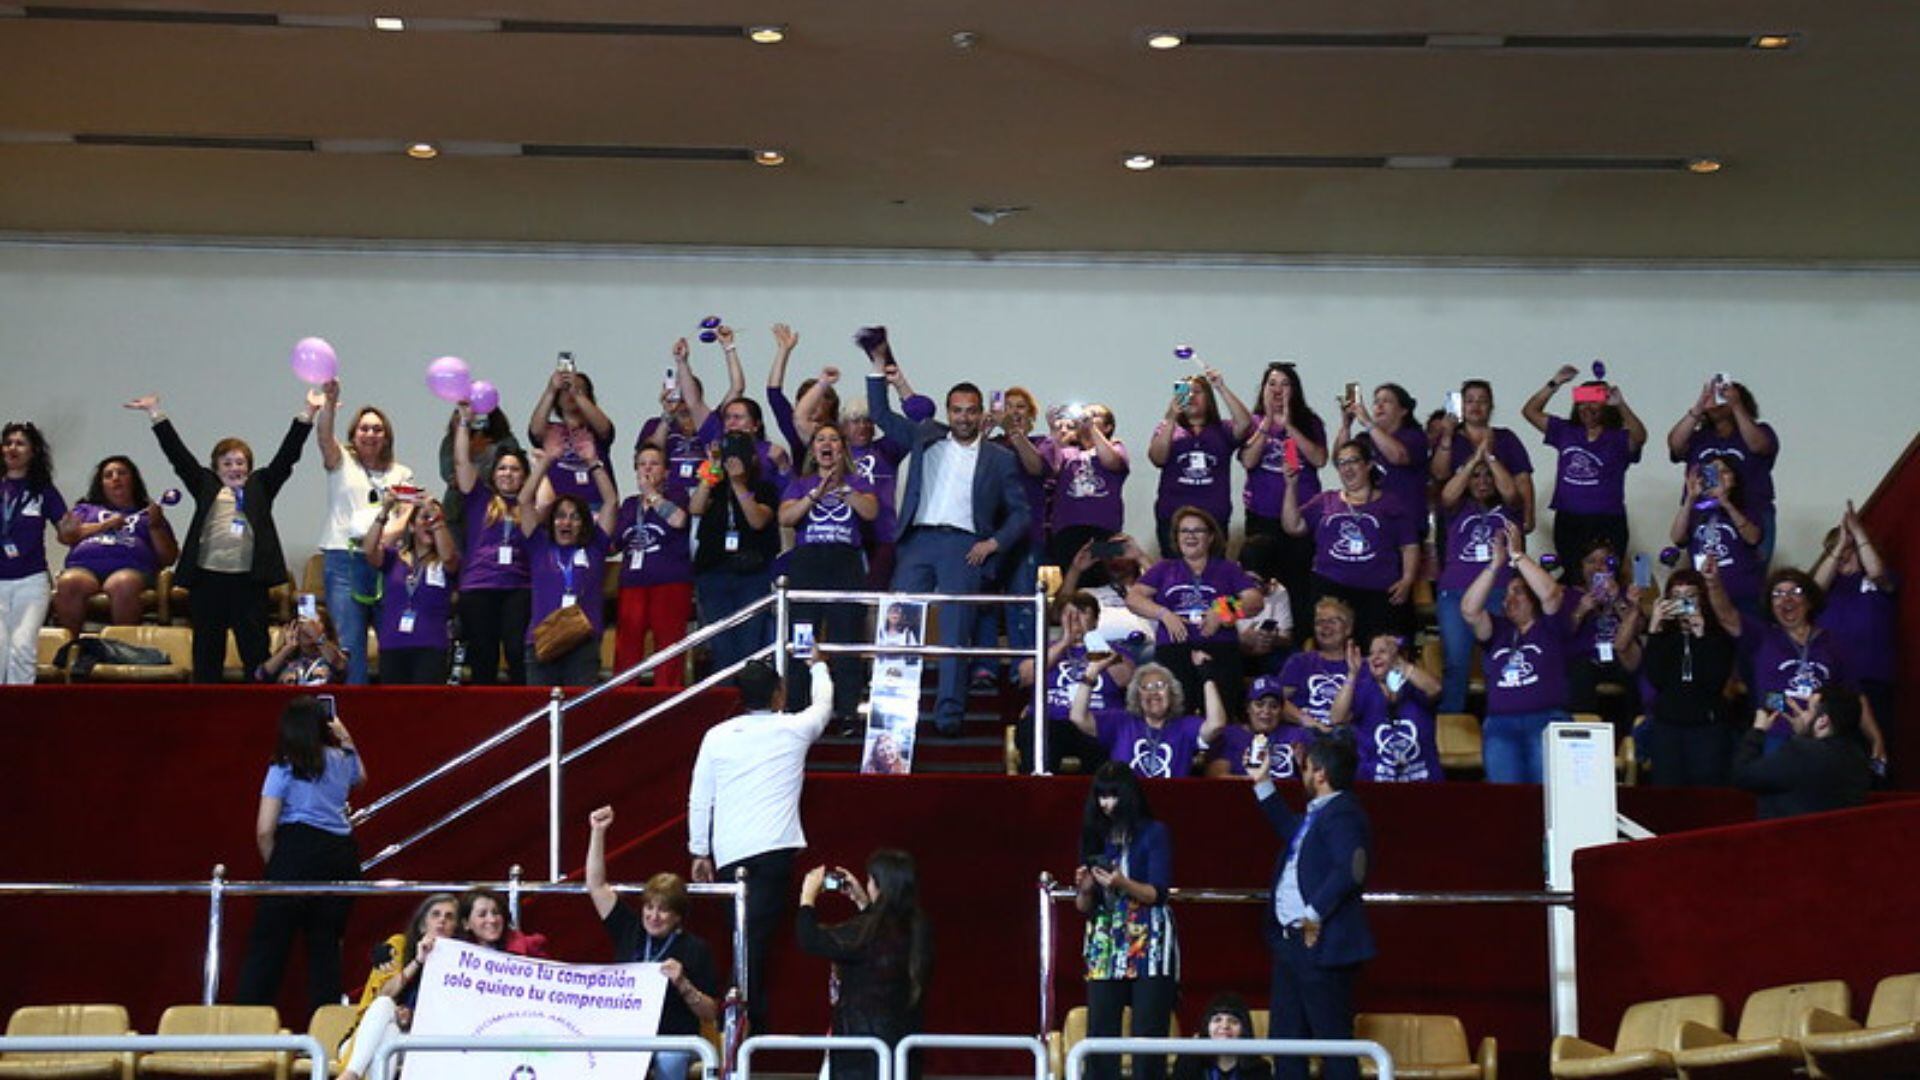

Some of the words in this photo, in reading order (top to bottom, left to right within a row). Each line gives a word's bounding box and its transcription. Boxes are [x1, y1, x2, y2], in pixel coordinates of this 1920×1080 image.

[459, 950, 481, 970] No
[485, 957, 534, 978] quiero
[537, 962, 554, 981] tu
[557, 969, 636, 990] compasión
[443, 972, 472, 989] solo
[475, 979, 525, 998] quiero
[528, 984, 546, 1000] tu
[548, 991, 643, 1010] comprensión
